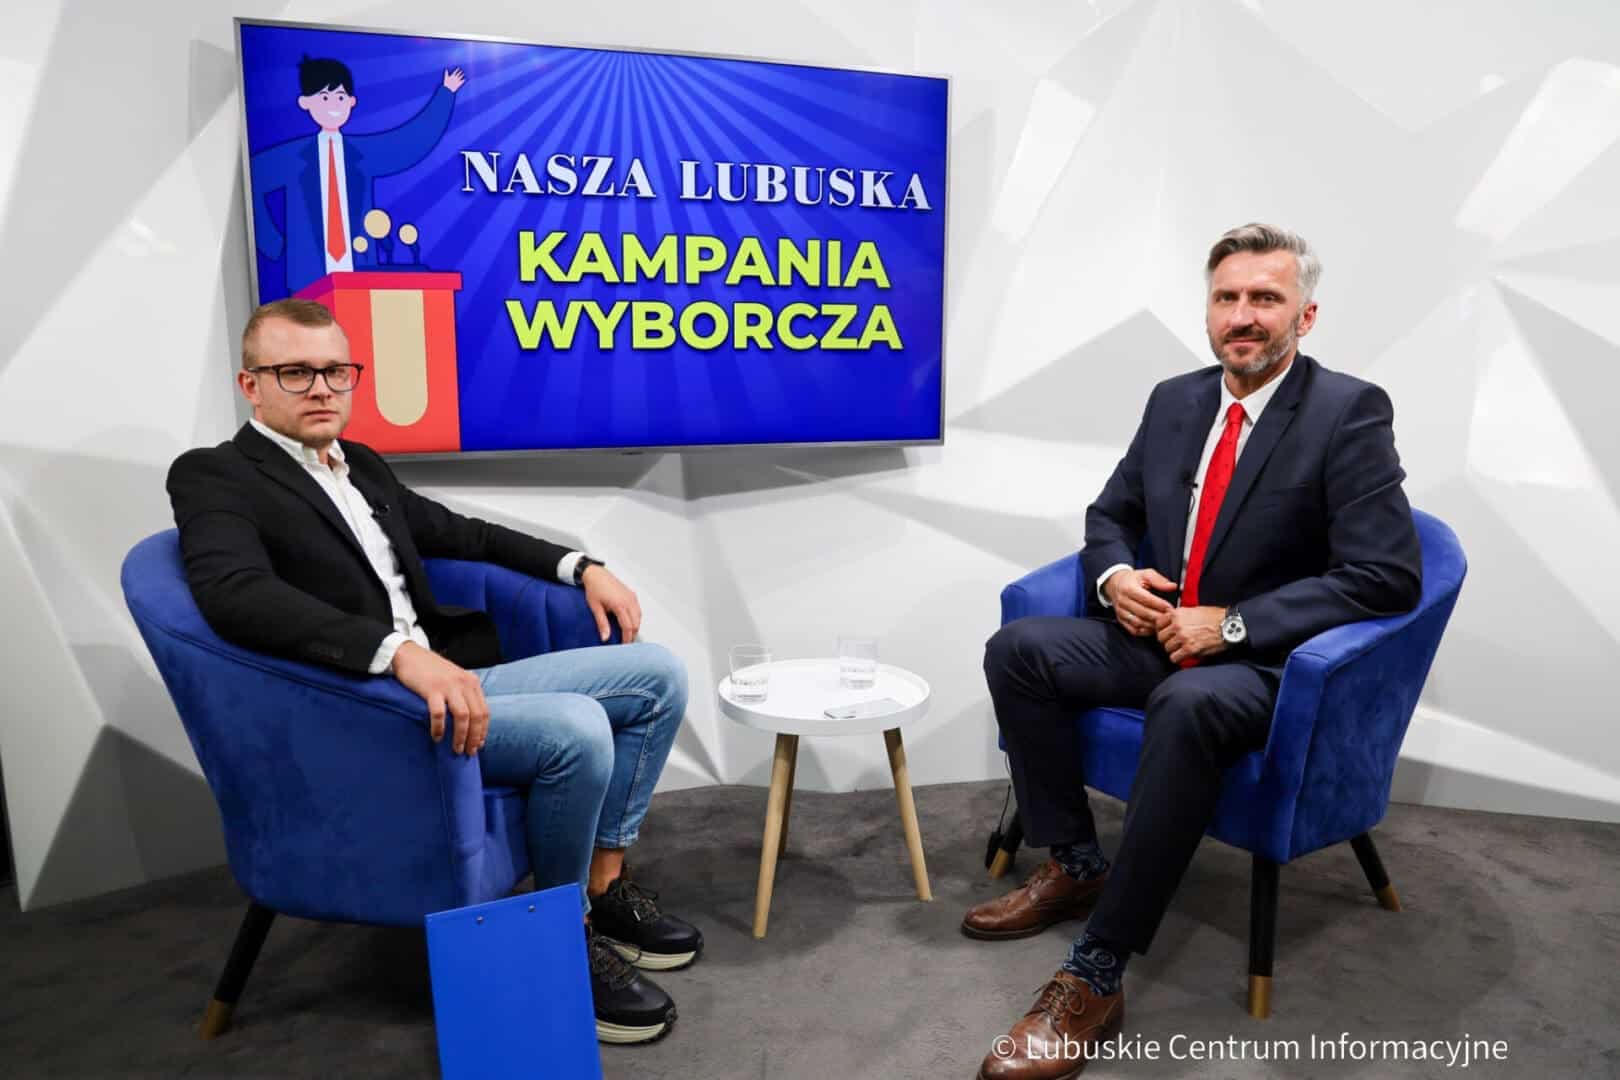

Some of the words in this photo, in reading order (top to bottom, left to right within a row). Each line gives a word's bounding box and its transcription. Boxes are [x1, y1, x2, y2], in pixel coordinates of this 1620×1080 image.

[461, 150, 656, 198] NASZA
[679, 160, 933, 210] LUBUSKA
[518, 230, 891, 288] KAMPANIA
[505, 299, 904, 350] WYBORCZA
